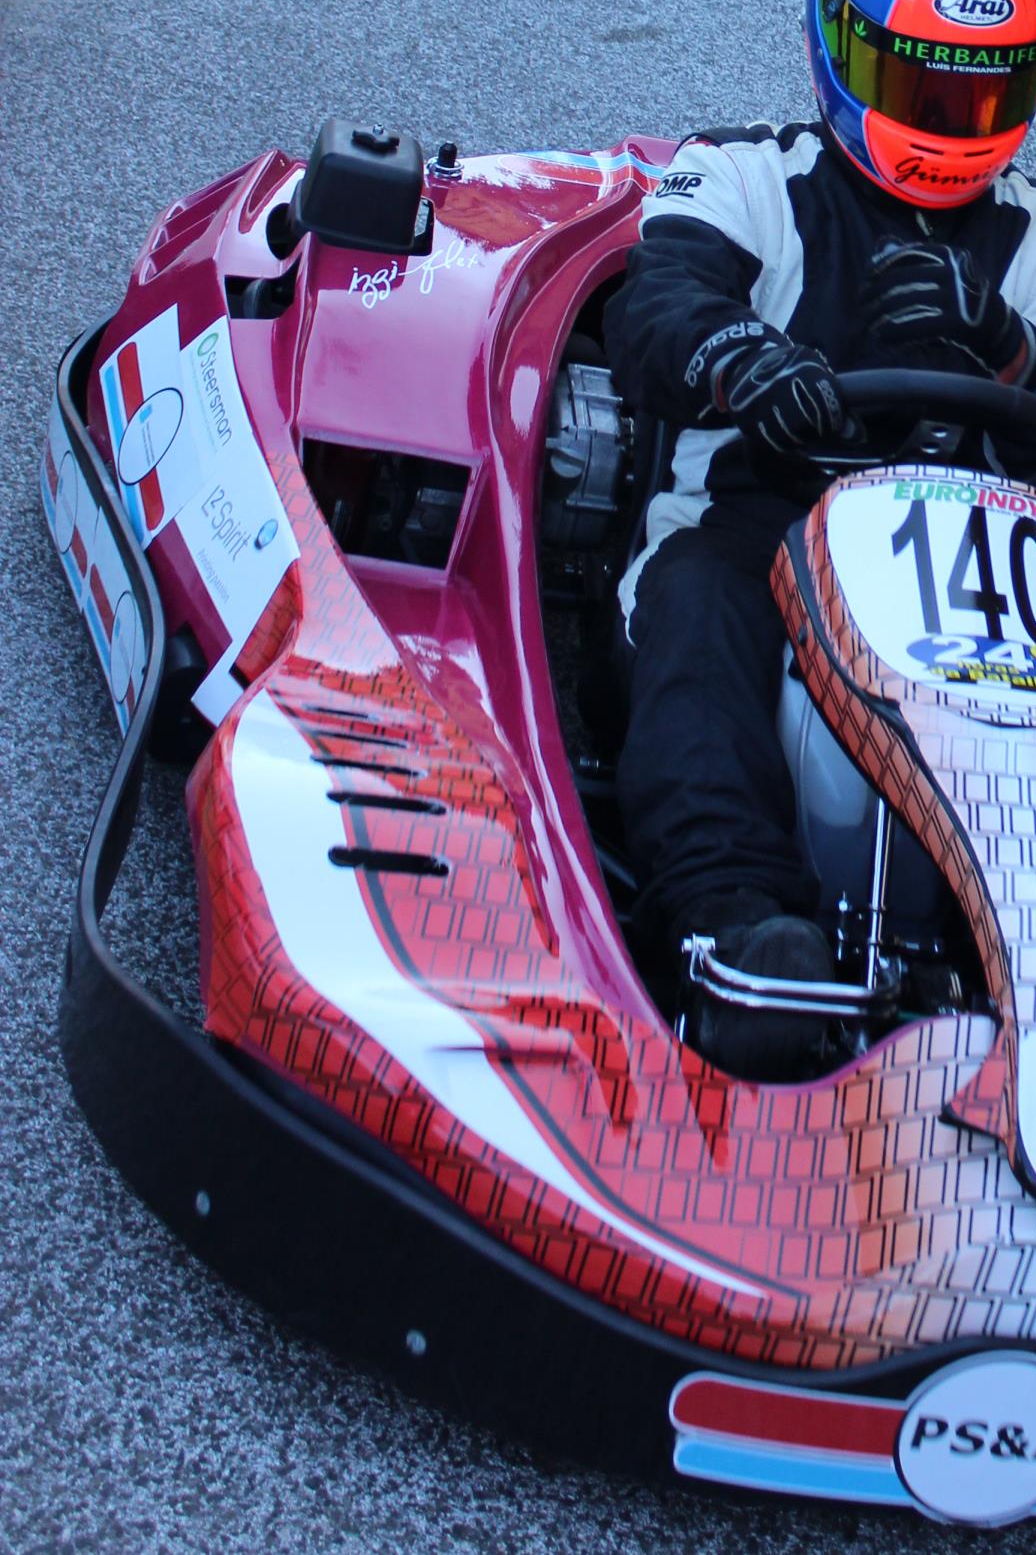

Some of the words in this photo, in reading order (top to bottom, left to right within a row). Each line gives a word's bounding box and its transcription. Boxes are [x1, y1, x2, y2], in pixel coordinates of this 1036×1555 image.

[953, 65, 1011, 74] FERNANDES
[656, 175, 702, 196] OMP
[683, 321, 766, 389] sparco
[199, 351, 233, 447] Steersman
[210, 501, 252, 562] Spirit
[931, 635, 1034, 673] 24
[957, 659, 1020, 674] horas
[930, 665, 961, 680] da
